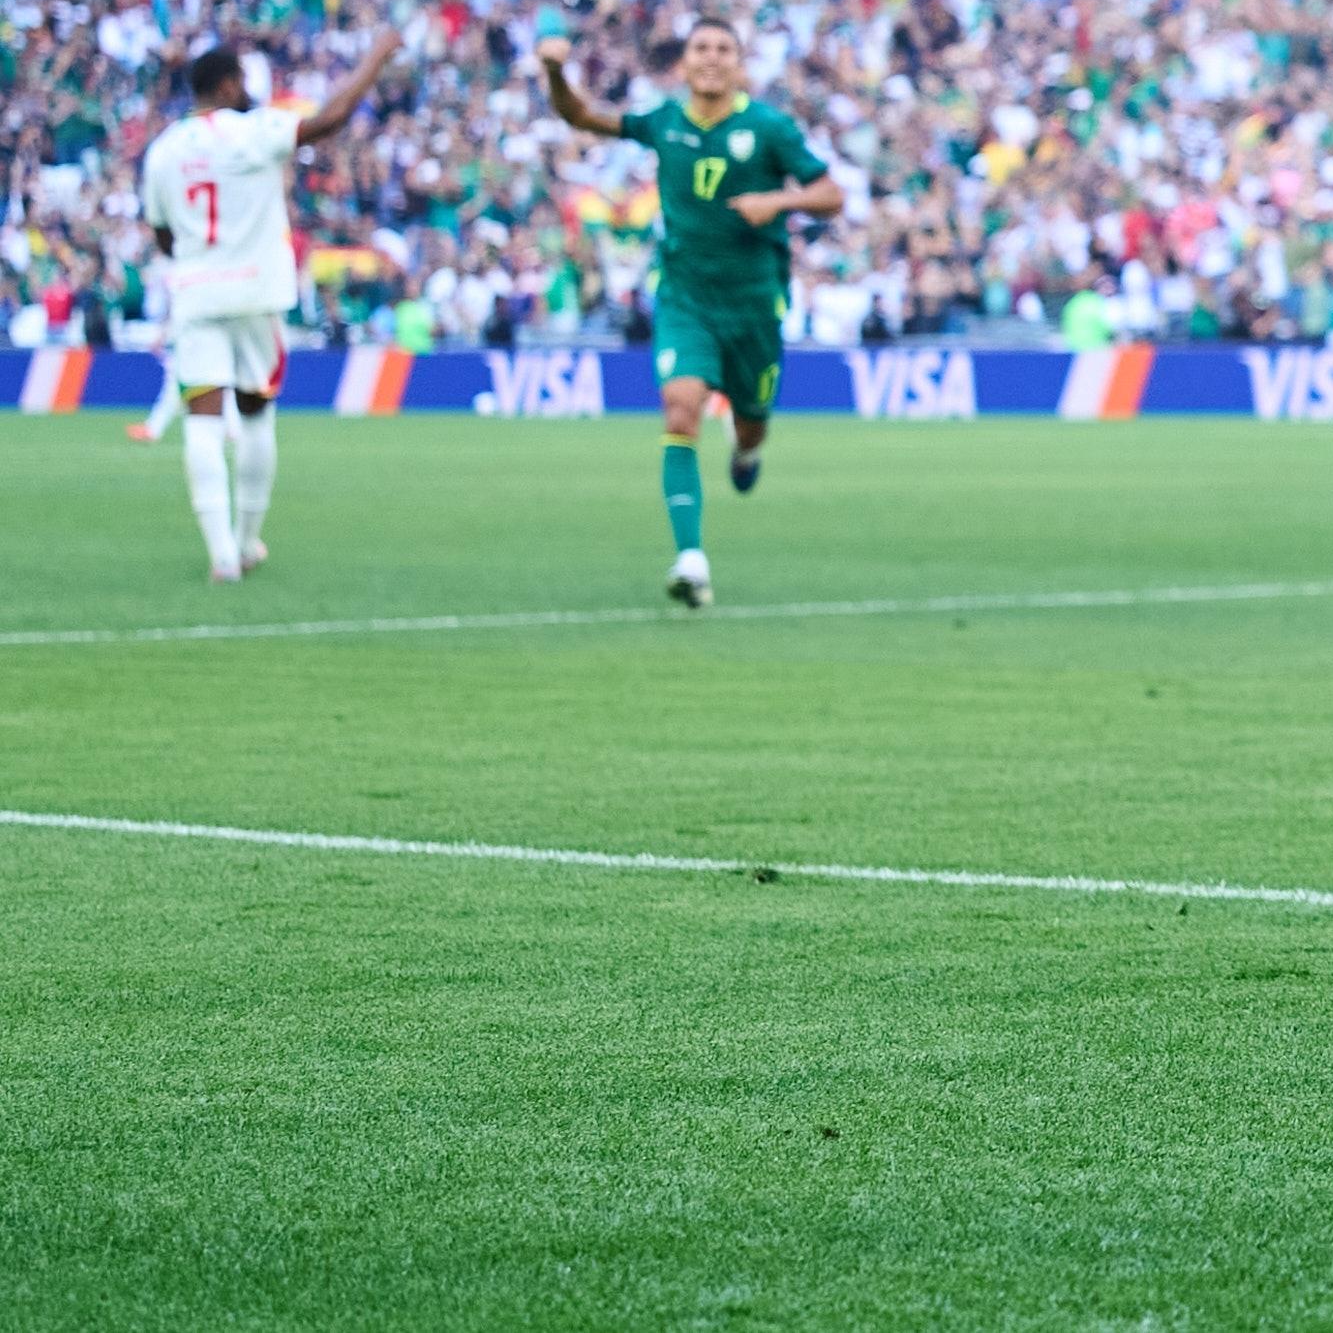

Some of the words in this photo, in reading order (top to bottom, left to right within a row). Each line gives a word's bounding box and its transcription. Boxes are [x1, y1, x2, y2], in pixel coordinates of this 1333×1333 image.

[693, 156, 728, 202] 17
[186, 181, 217, 246] 7
[486, 349, 604, 418] VISA
[845, 349, 978, 418] VISA
